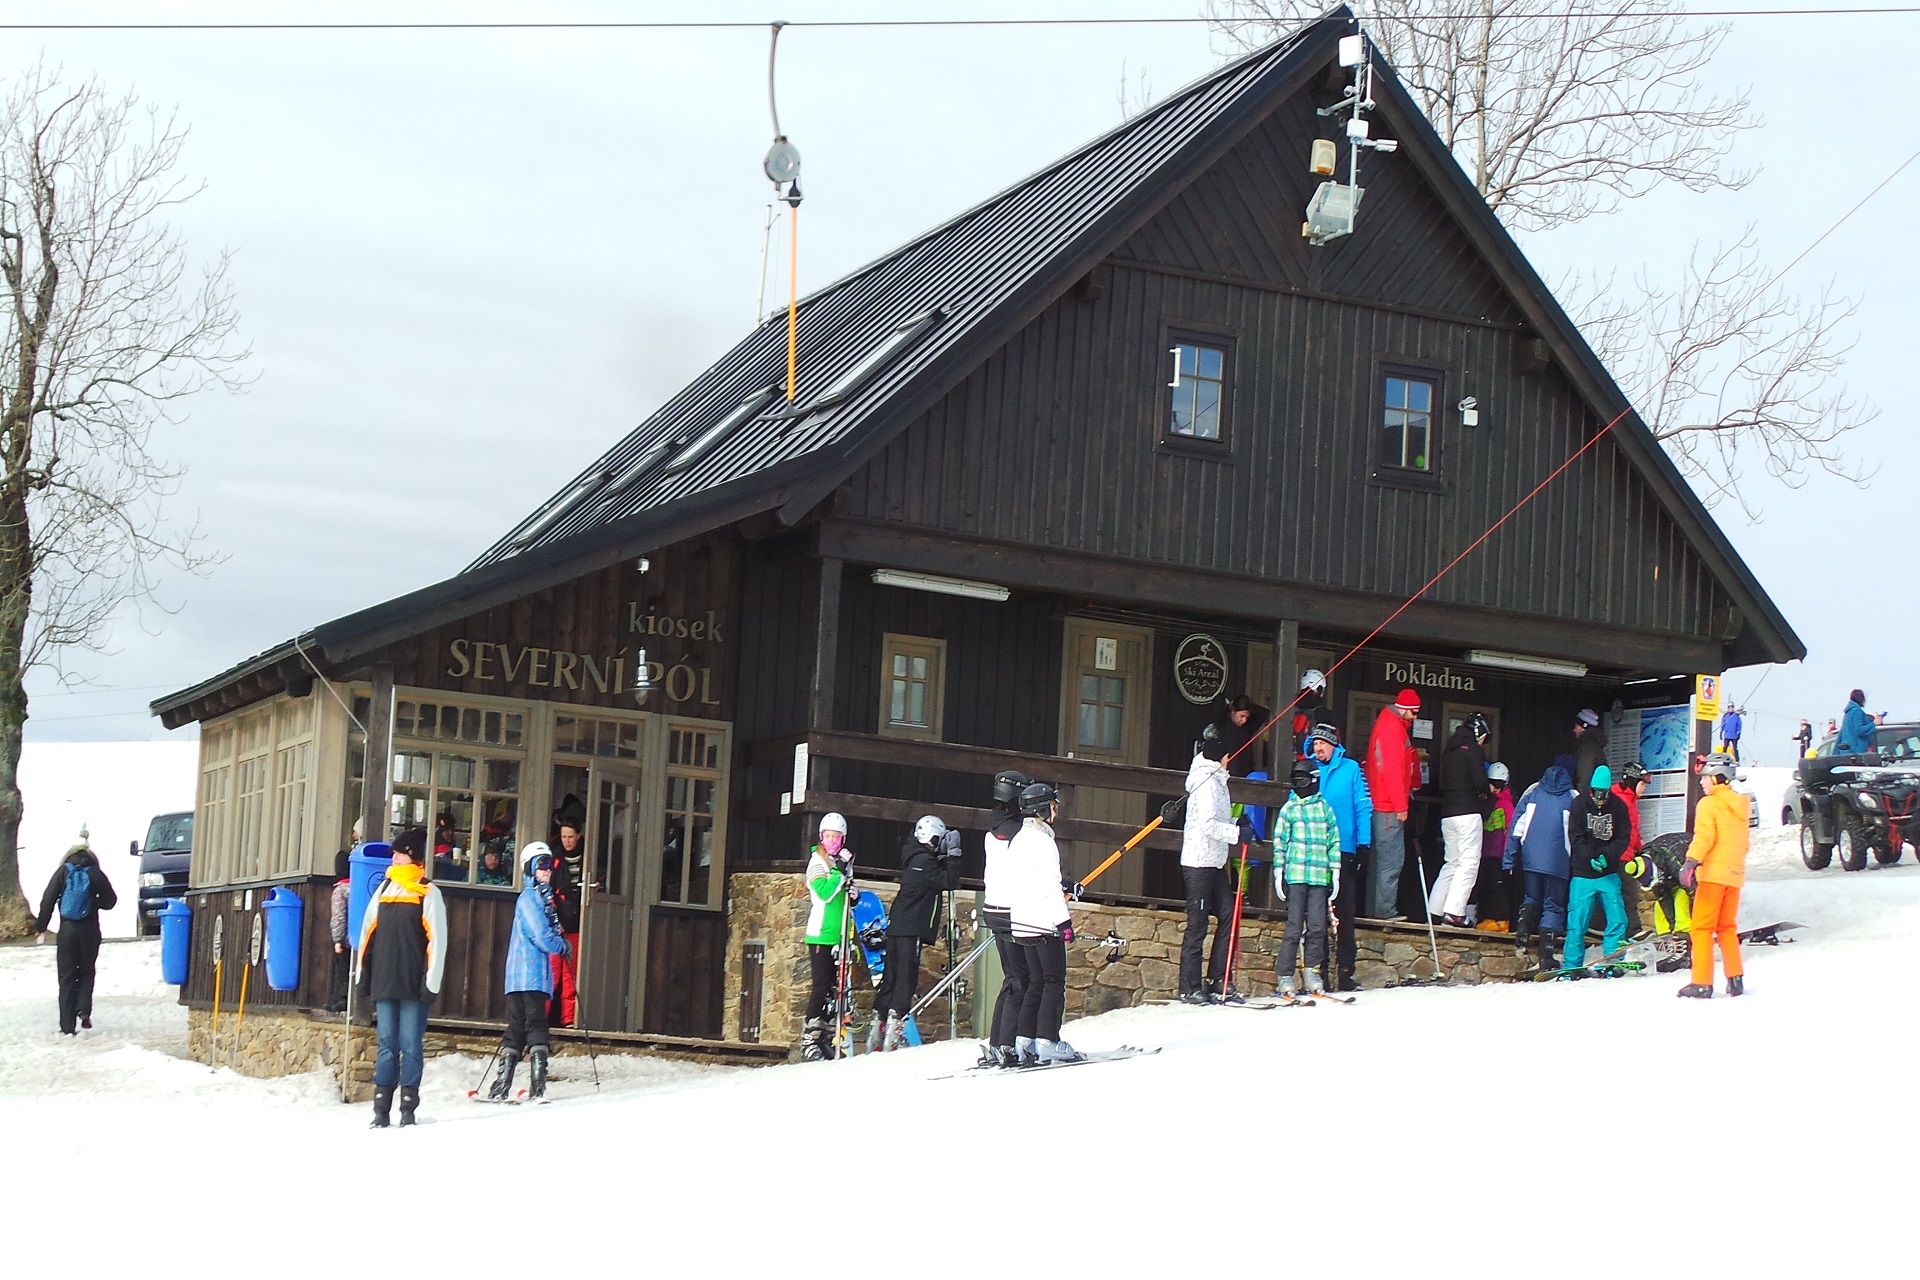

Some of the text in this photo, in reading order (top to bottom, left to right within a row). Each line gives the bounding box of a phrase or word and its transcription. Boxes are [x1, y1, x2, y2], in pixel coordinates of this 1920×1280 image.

[628, 601, 723, 643] kiosek
[446, 638, 628, 696] SEVERNÍ
[1385, 661, 1475, 692] Pokladna
